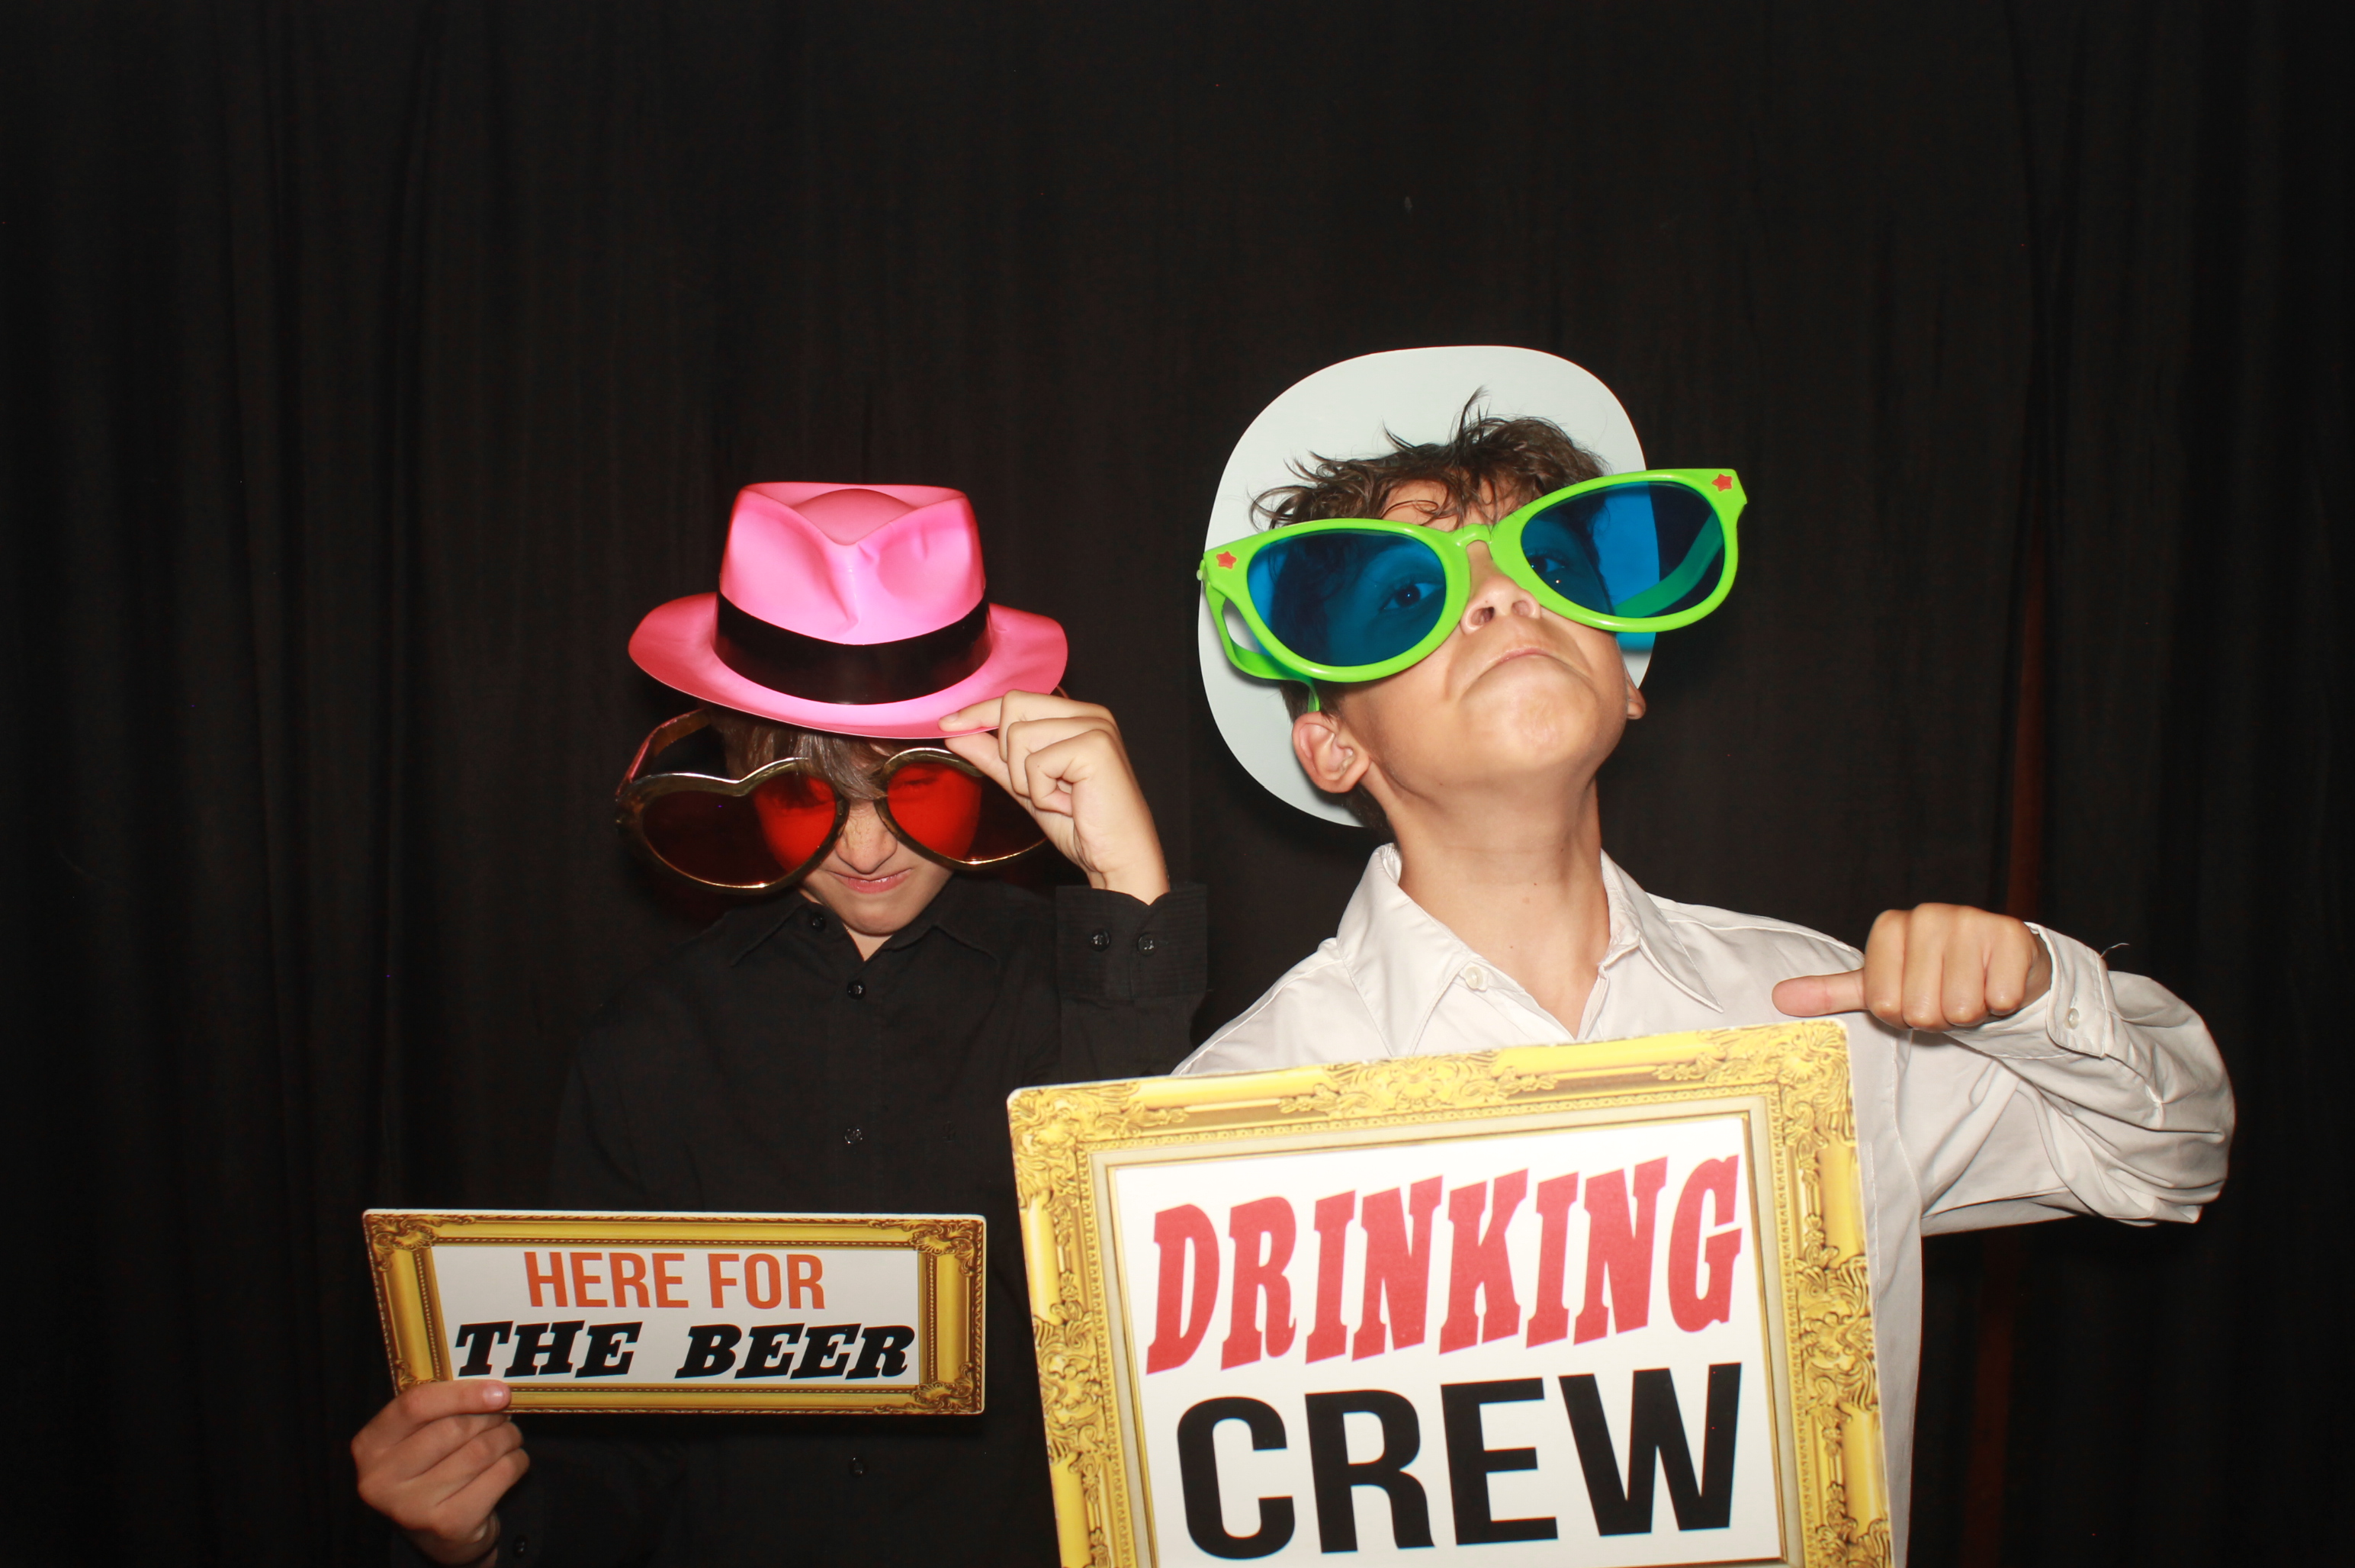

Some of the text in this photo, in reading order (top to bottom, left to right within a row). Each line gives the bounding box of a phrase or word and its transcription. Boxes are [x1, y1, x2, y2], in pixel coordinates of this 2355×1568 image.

[523, 1252, 826, 1310] HERE FOR
[1145, 1154, 1743, 1375] DRINKING
[455, 1320, 915, 1380] THE BEER
[1176, 1361, 1743, 1560] CREW
